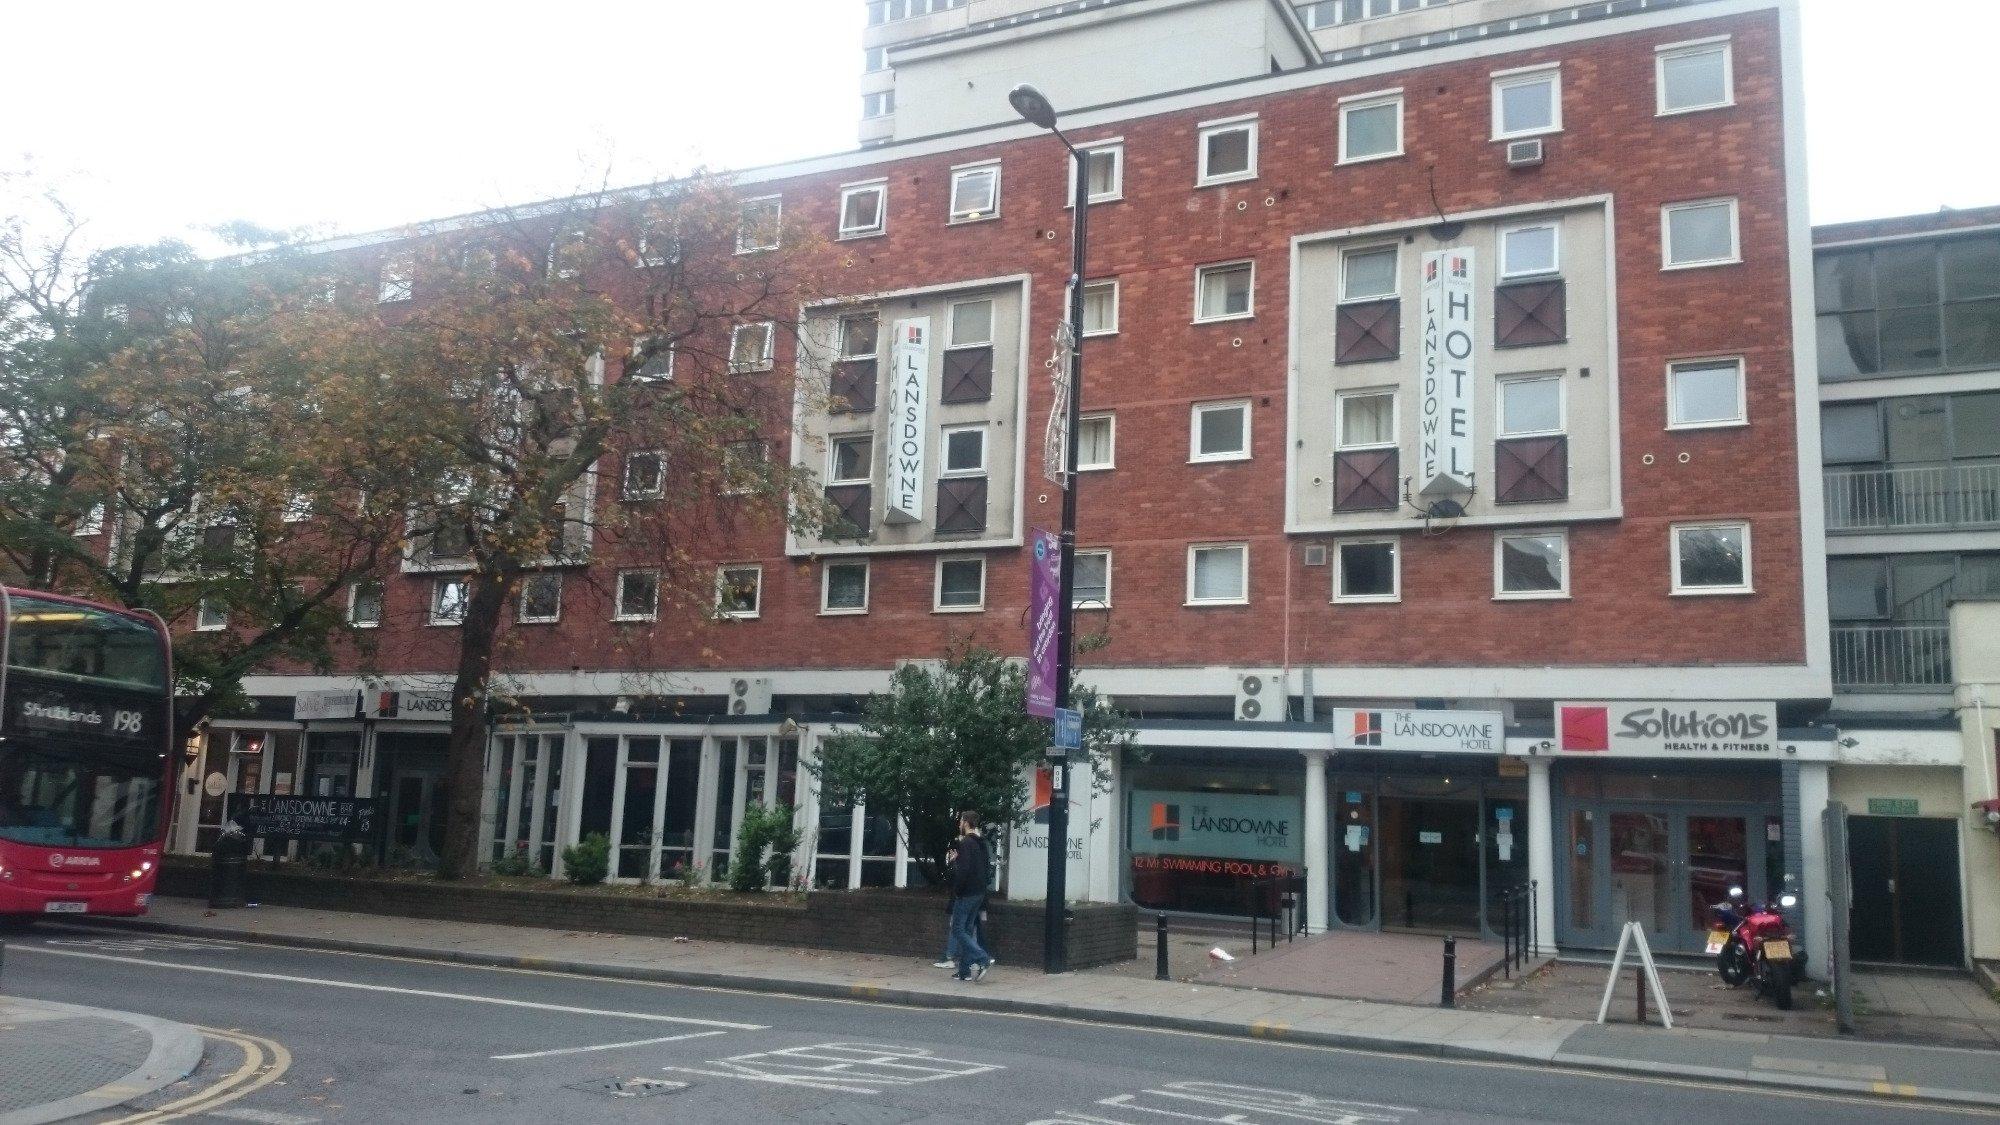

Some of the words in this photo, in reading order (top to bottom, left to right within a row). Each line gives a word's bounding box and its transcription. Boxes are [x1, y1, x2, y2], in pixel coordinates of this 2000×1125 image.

[1423, 298, 1438, 478] LANSDOWNE
[1446, 291, 1472, 475] HOTEL
[899, 355, 920, 510] LANSDOWNE
[407, 699, 452, 712] LANSDO
[113, 710, 143, 733] 198
[1395, 713, 1412, 722] THE
[1614, 708, 1769, 739] Solutions
[1394, 723, 1493, 739] LANSDOWNE
[1461, 739, 1492, 750] HOTEL
[1723, 743, 1770, 751] FITNESS
[268, 800, 337, 816] LANSDOWNE
[1193, 806, 1208, 815] THE
[1192, 816, 1289, 836] LANSDOWNE
[1016, 836, 1082, 849] LANSDNE
[1257, 836, 1288, 848] HOTEL
[1163, 857, 1221, 873] SWIMMING
[1224, 862, 1257, 876] POOL
[1258, 864, 1267, 876] &
